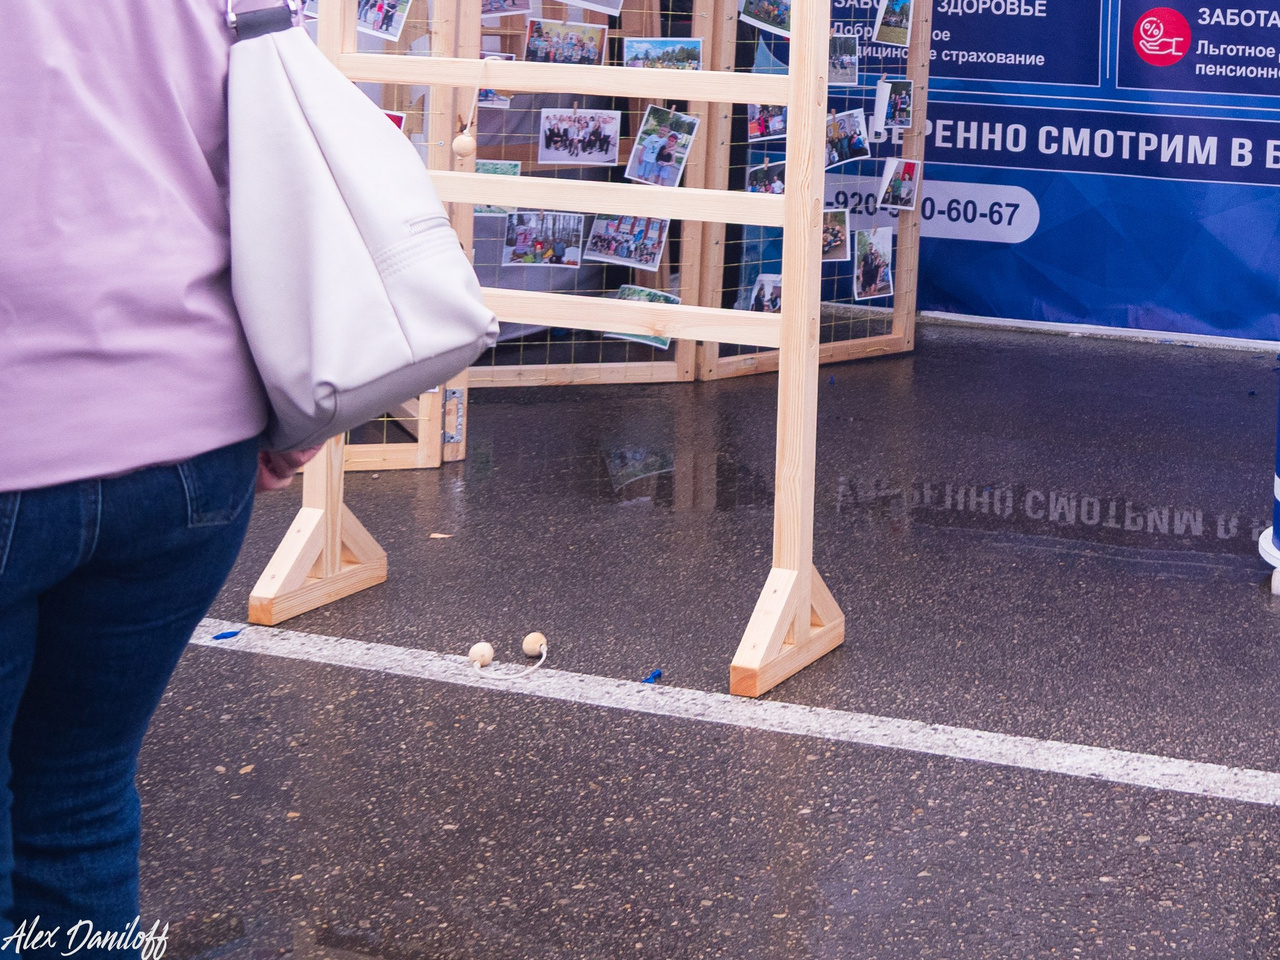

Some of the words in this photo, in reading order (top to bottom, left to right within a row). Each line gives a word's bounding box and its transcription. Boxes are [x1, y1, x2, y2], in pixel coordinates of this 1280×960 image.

[941, 49, 1045, 66] страхование
[1196, 40, 1276, 58] Льготное
[1037, 125, 1218, 166] СМОТРИМ
[1230, 138, 1254, 168] В
